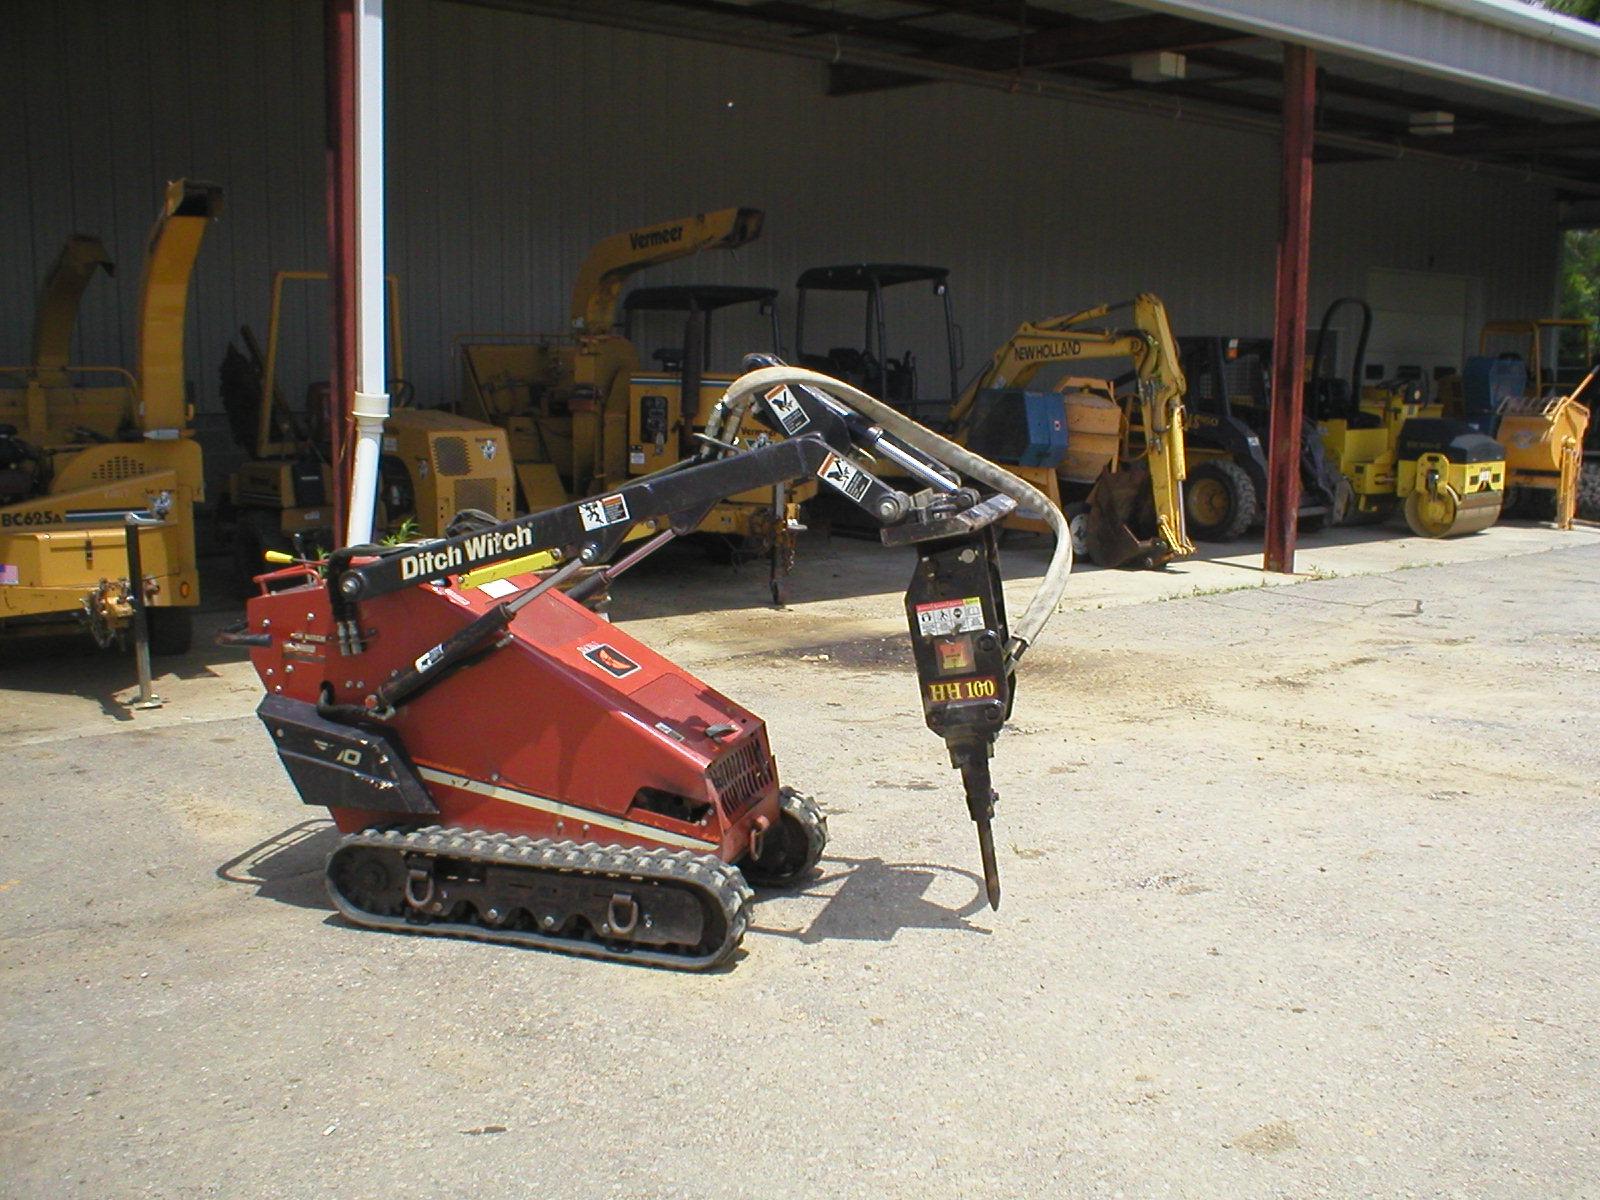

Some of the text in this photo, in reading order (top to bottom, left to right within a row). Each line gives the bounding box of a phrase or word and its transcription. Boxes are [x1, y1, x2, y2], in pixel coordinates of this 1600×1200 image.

[629, 226, 683, 251] Vermeer
[1014, 339, 1081, 361] NEW HOLLAND
[2, 510, 63, 528] BC625A
[401, 524, 533, 580] Ditch Witch
[929, 679, 995, 702] HH 100
